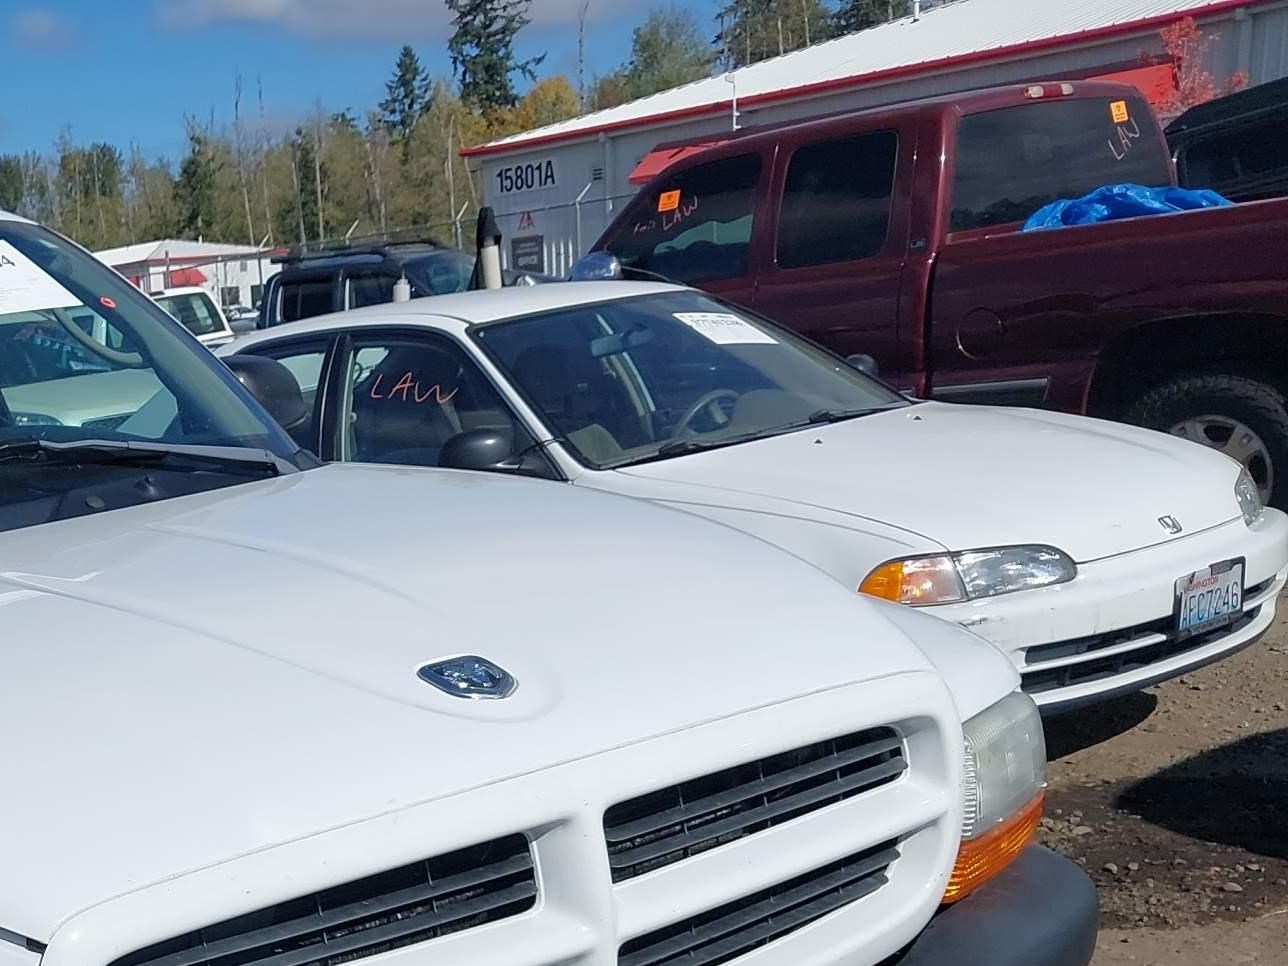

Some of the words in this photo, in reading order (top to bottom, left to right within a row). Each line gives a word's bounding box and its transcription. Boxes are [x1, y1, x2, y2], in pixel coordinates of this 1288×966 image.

[1107, 116, 1140, 160] LAW
[496, 160, 556, 193] 15801A
[370, 371, 460, 404] LAW
[1181, 581, 1239, 628] AFC7246
